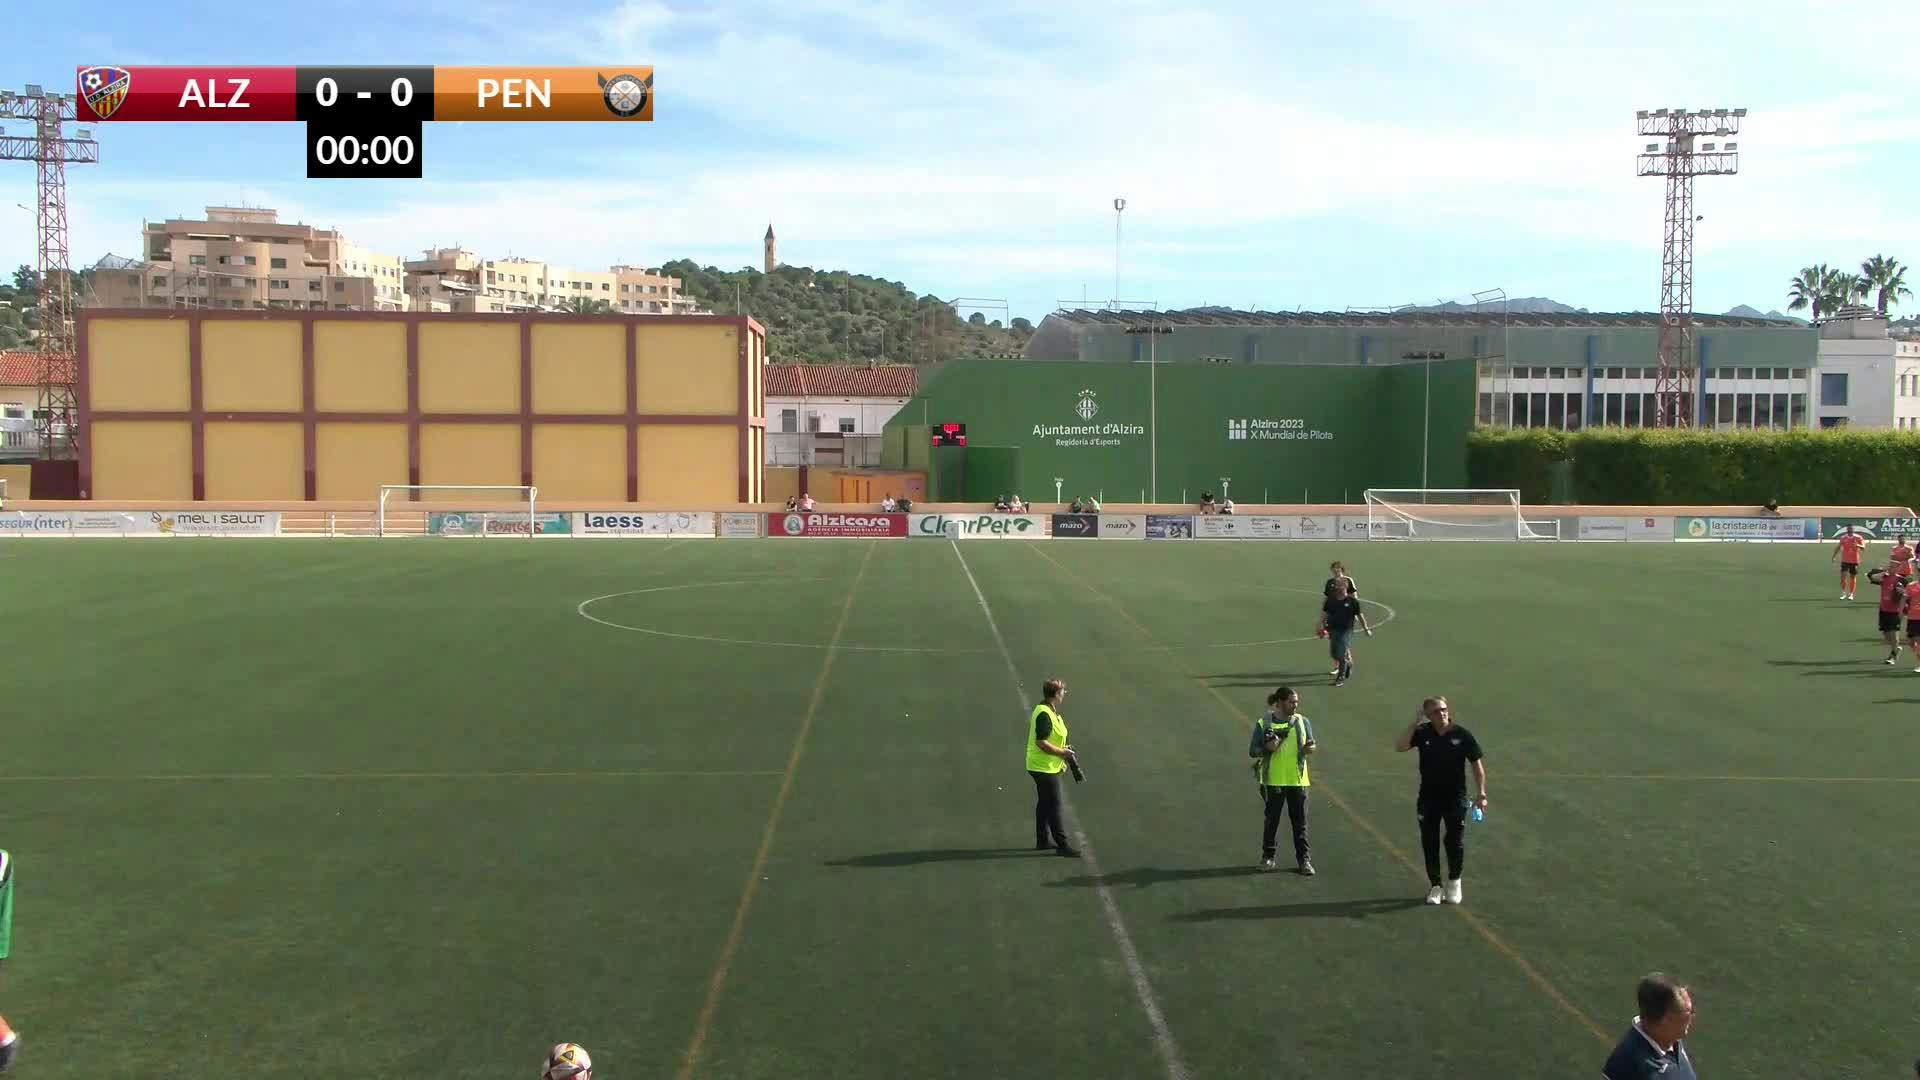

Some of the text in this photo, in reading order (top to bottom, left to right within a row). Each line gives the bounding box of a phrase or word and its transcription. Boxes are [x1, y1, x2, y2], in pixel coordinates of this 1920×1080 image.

[1250, 419, 1304, 429] Alzira 2023
[1032, 423, 1144, 438] Ajuntament d'Alzira
[1250, 429, 1334, 440] X Mundial de Pilota
[584, 512, 644, 528] laess
[807, 514, 891, 527] Alzicasa
[1712, 520, 1721, 530] la
